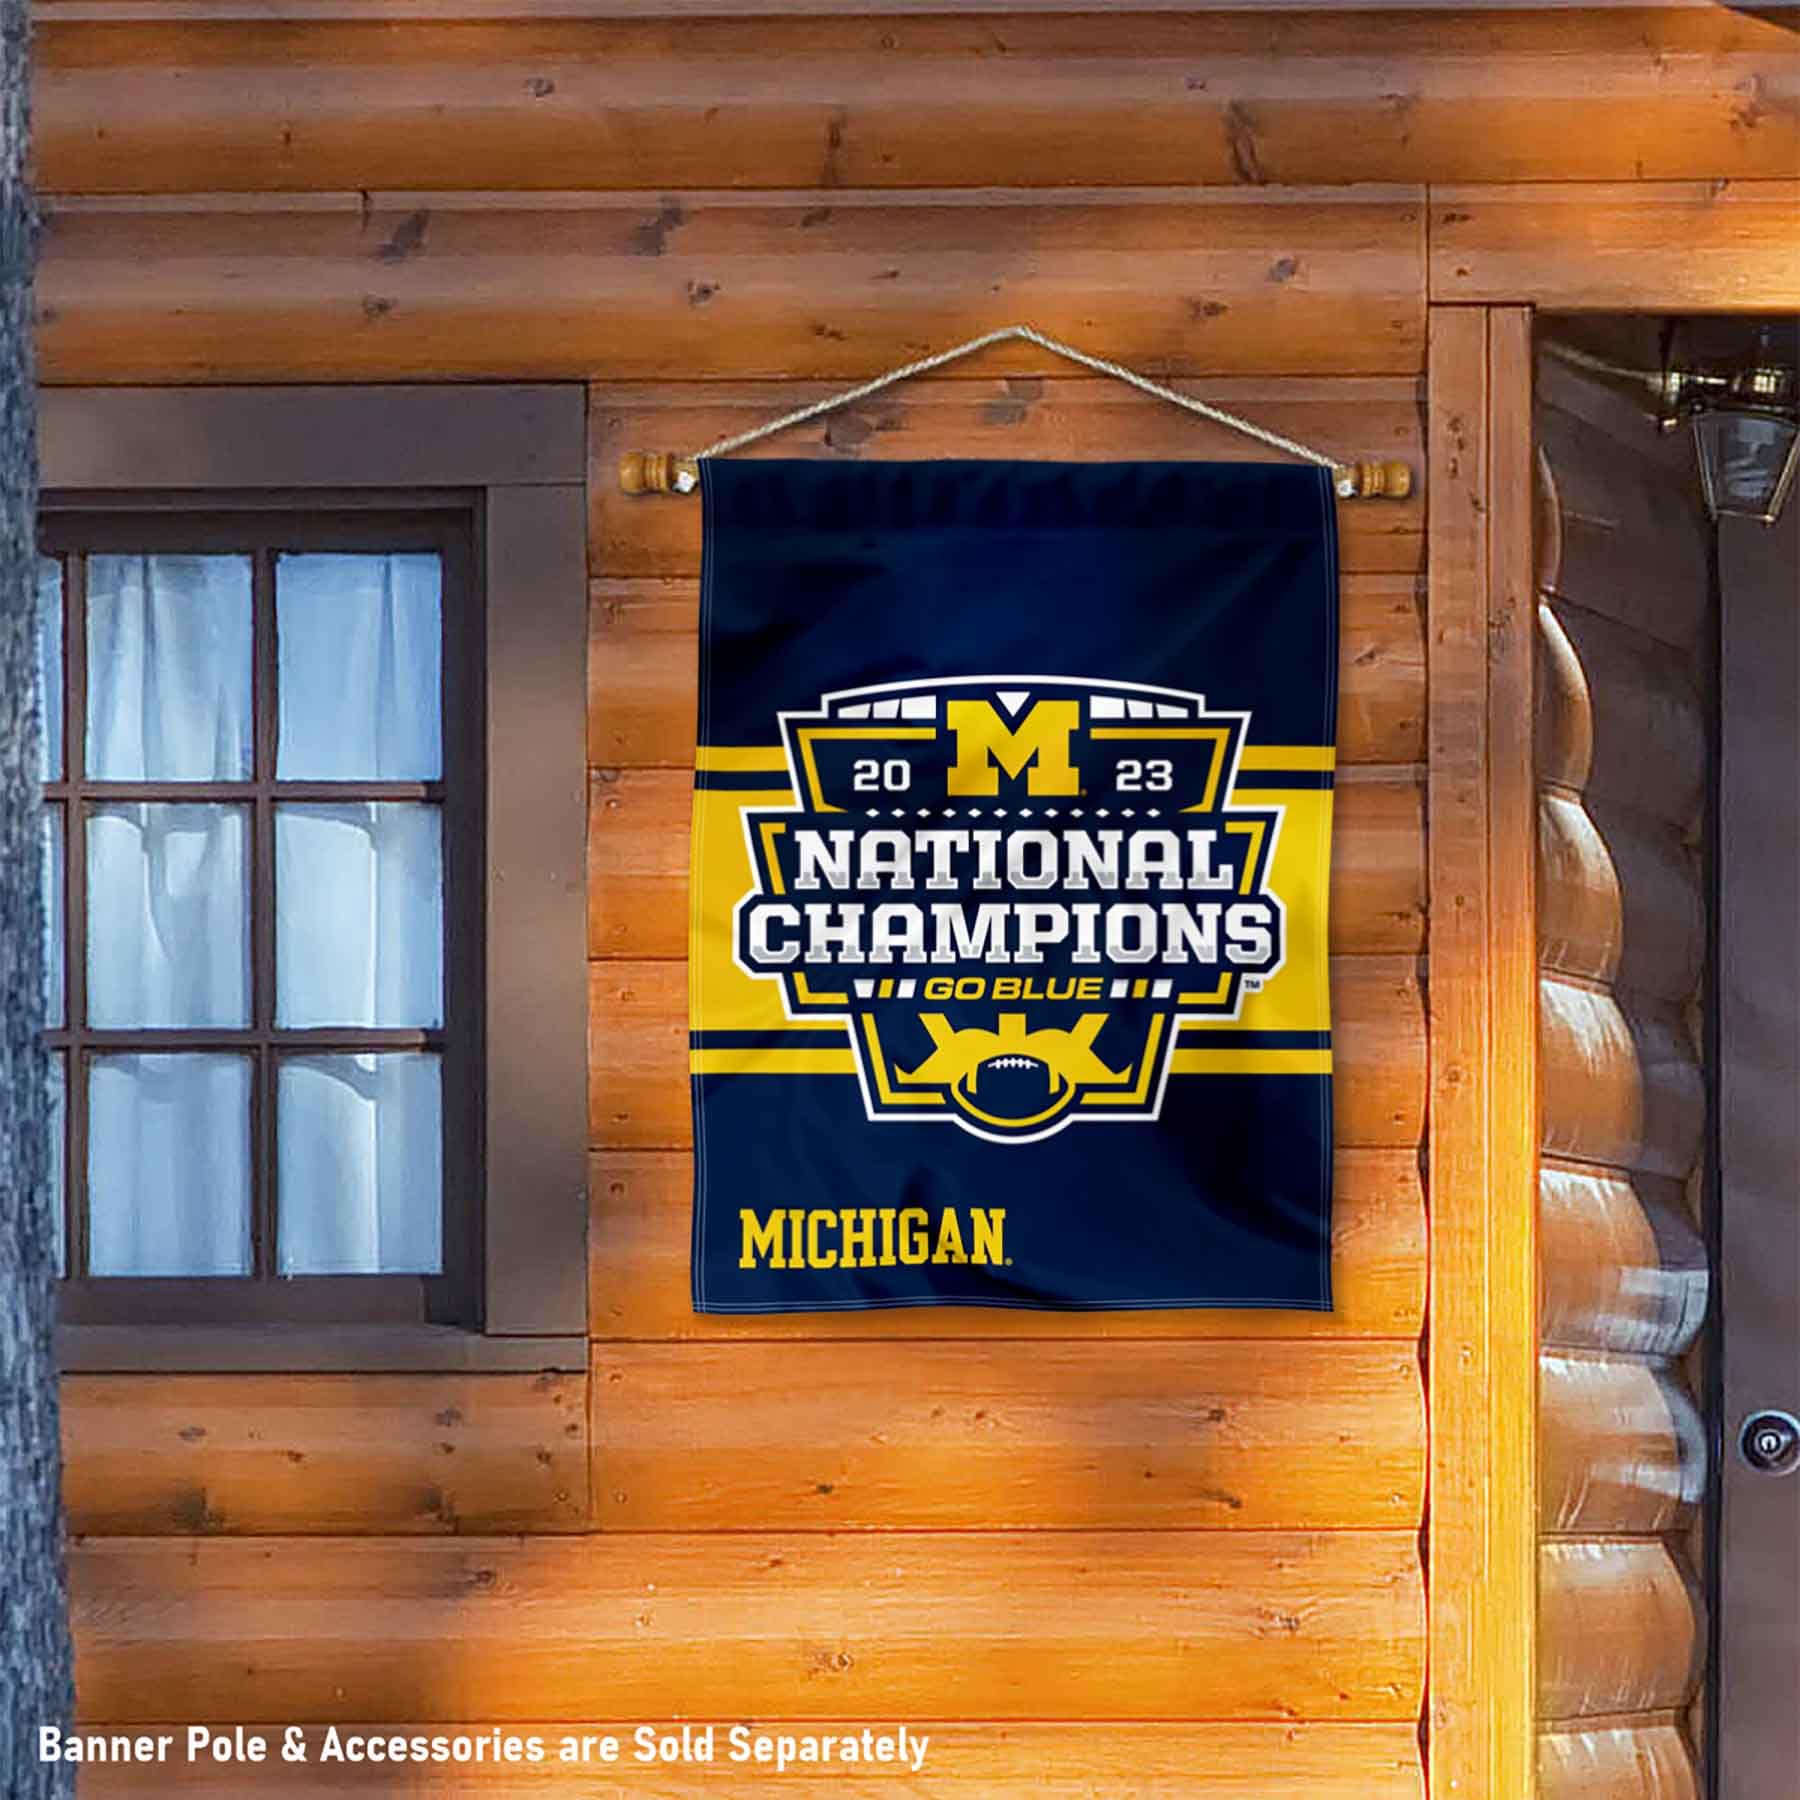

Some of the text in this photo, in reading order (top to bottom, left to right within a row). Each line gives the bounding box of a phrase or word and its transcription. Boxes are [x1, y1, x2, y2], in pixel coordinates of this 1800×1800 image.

[852, 759, 911, 792] 20
[946, 699, 1081, 796] M
[1115, 759, 1174, 792] 23
[793, 829, 1234, 890] NATIONAL
[749, 903, 1273, 964] CHAMPIONS
[924, 977, 1104, 1000] GO BLUE
[739, 1207, 1007, 1269] MICHIGAN
